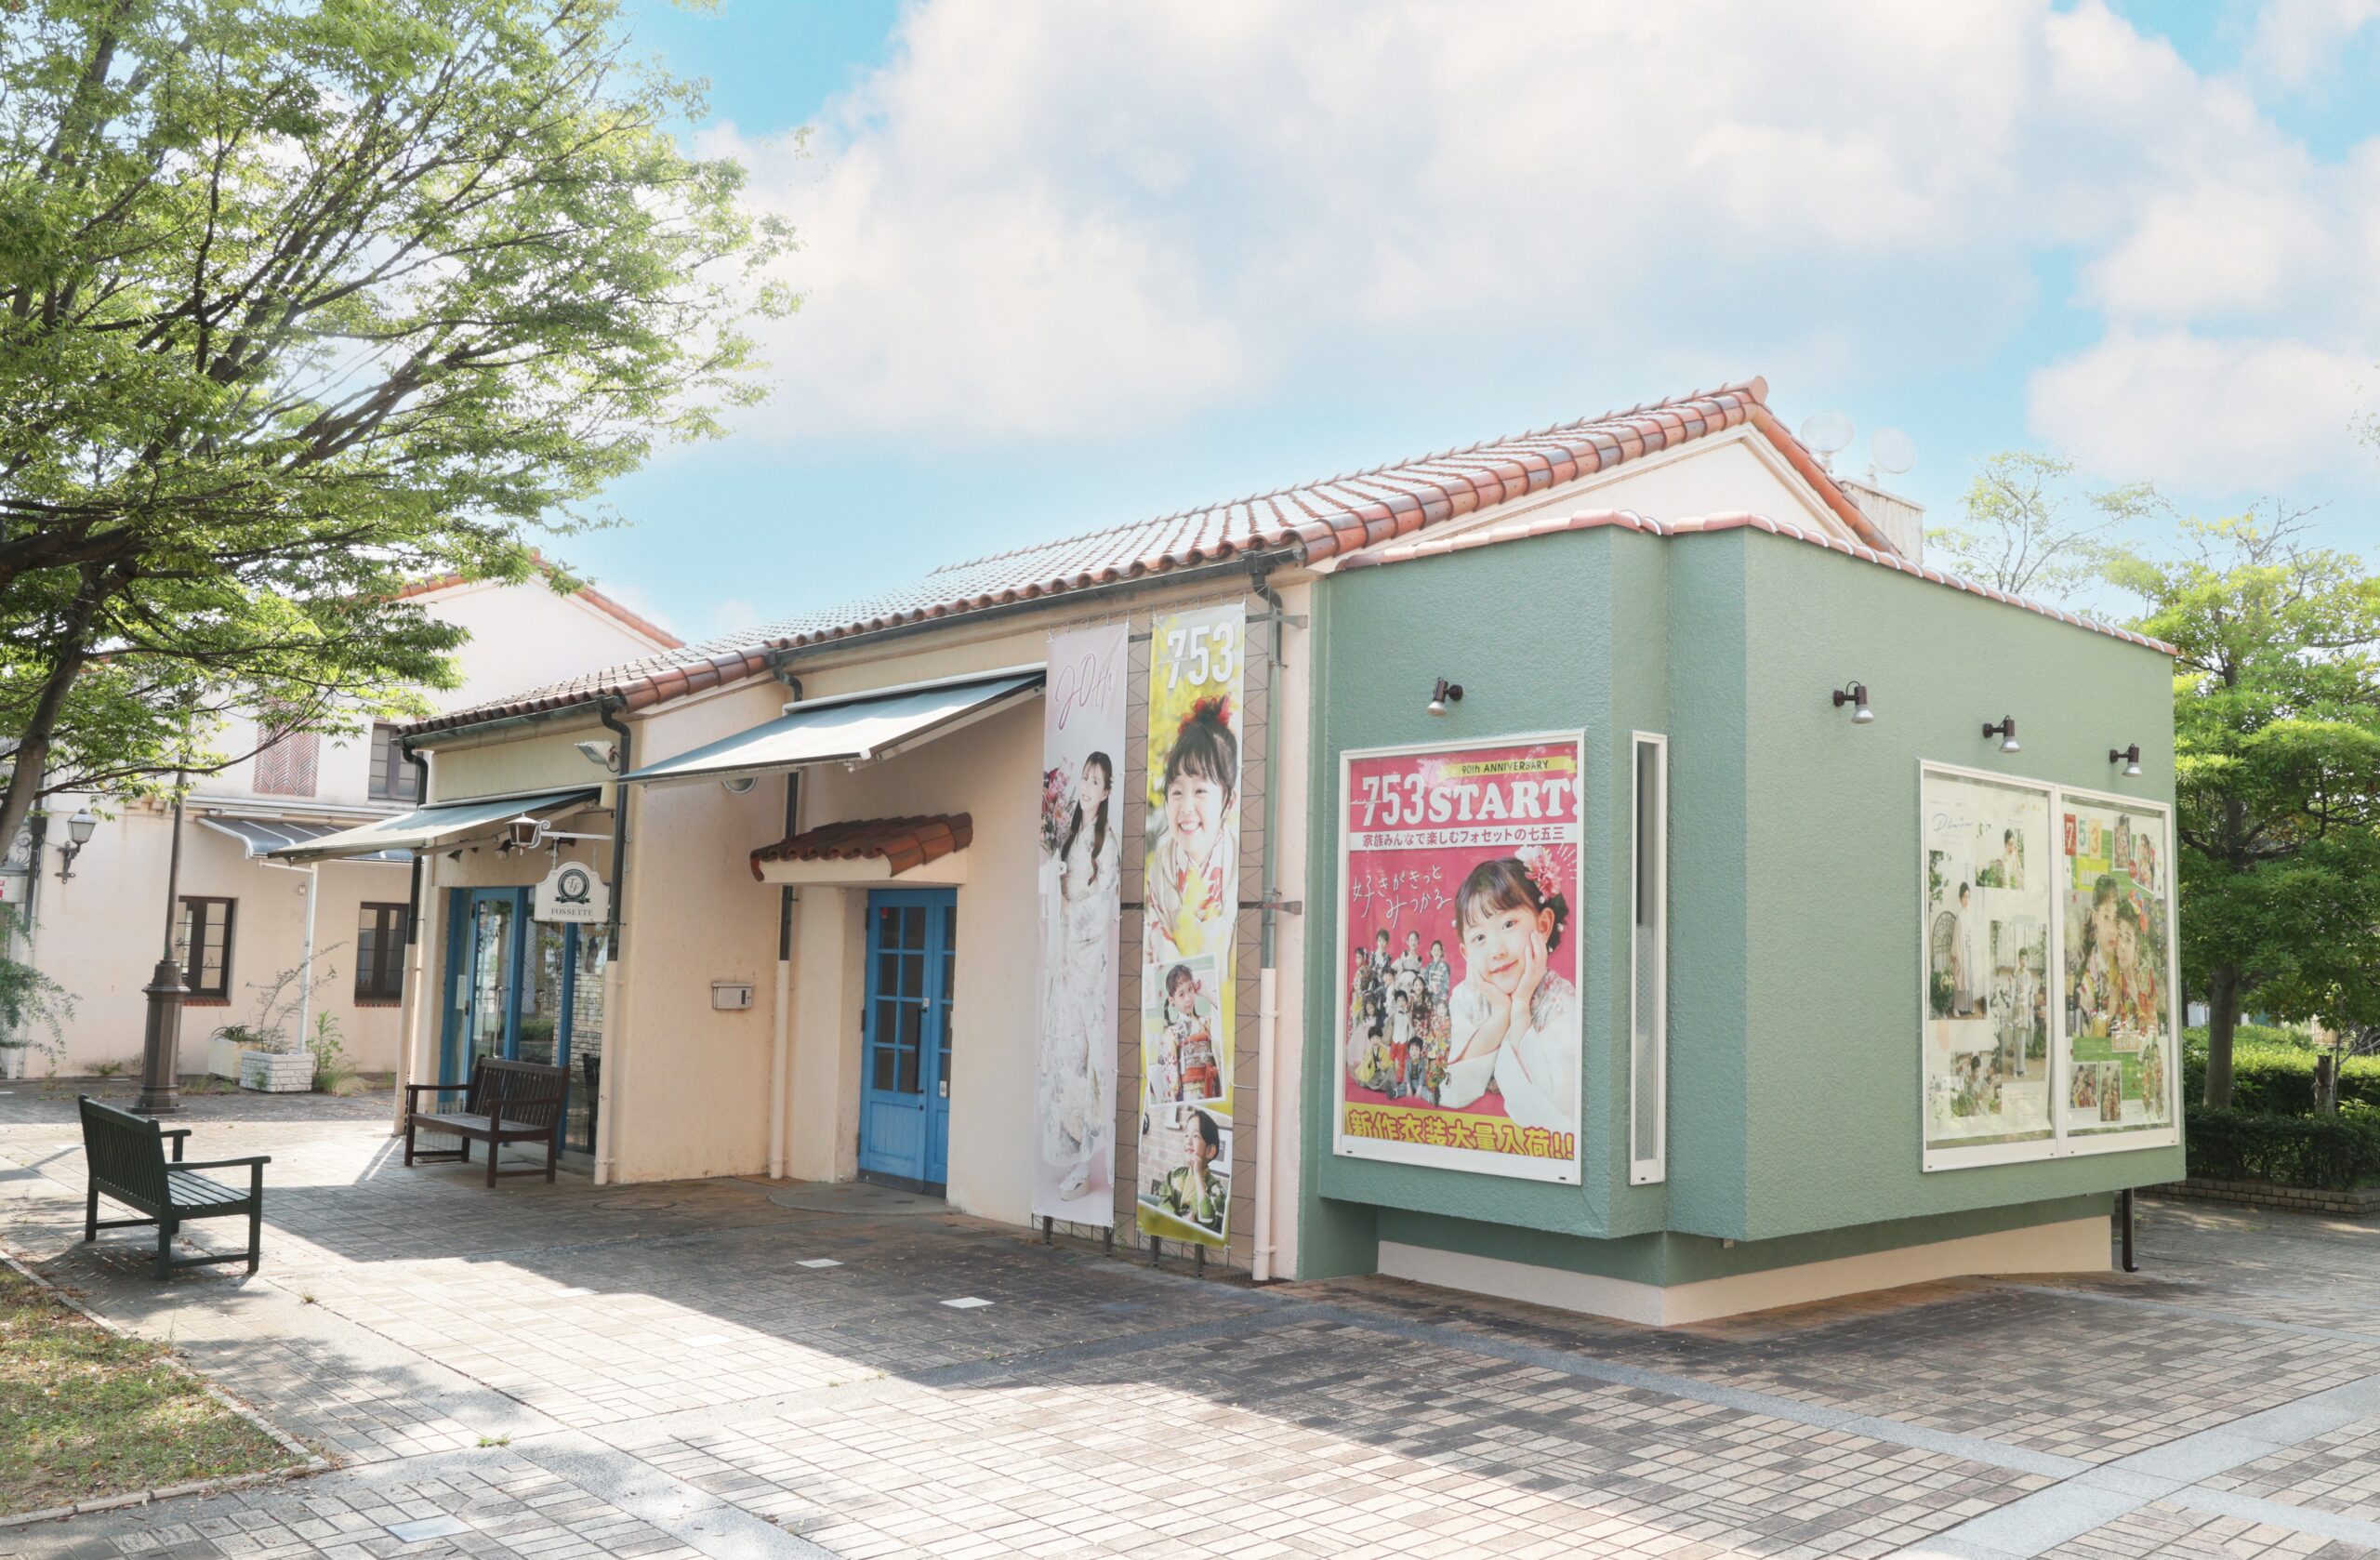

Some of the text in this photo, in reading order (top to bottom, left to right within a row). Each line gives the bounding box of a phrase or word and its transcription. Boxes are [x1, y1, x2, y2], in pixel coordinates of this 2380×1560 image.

[1168, 622, 1235, 689] 753
[1461, 760, 1549, 774] 90th ANNIVERSARY
[1362, 826, 1565, 848] 家族みんなで楽しむフォセットの七五三
[1353, 865, 1442, 919] 好きがきっと
[550, 907, 593, 917] FOSSETTE
[1386, 889, 1452, 929] みつかる
